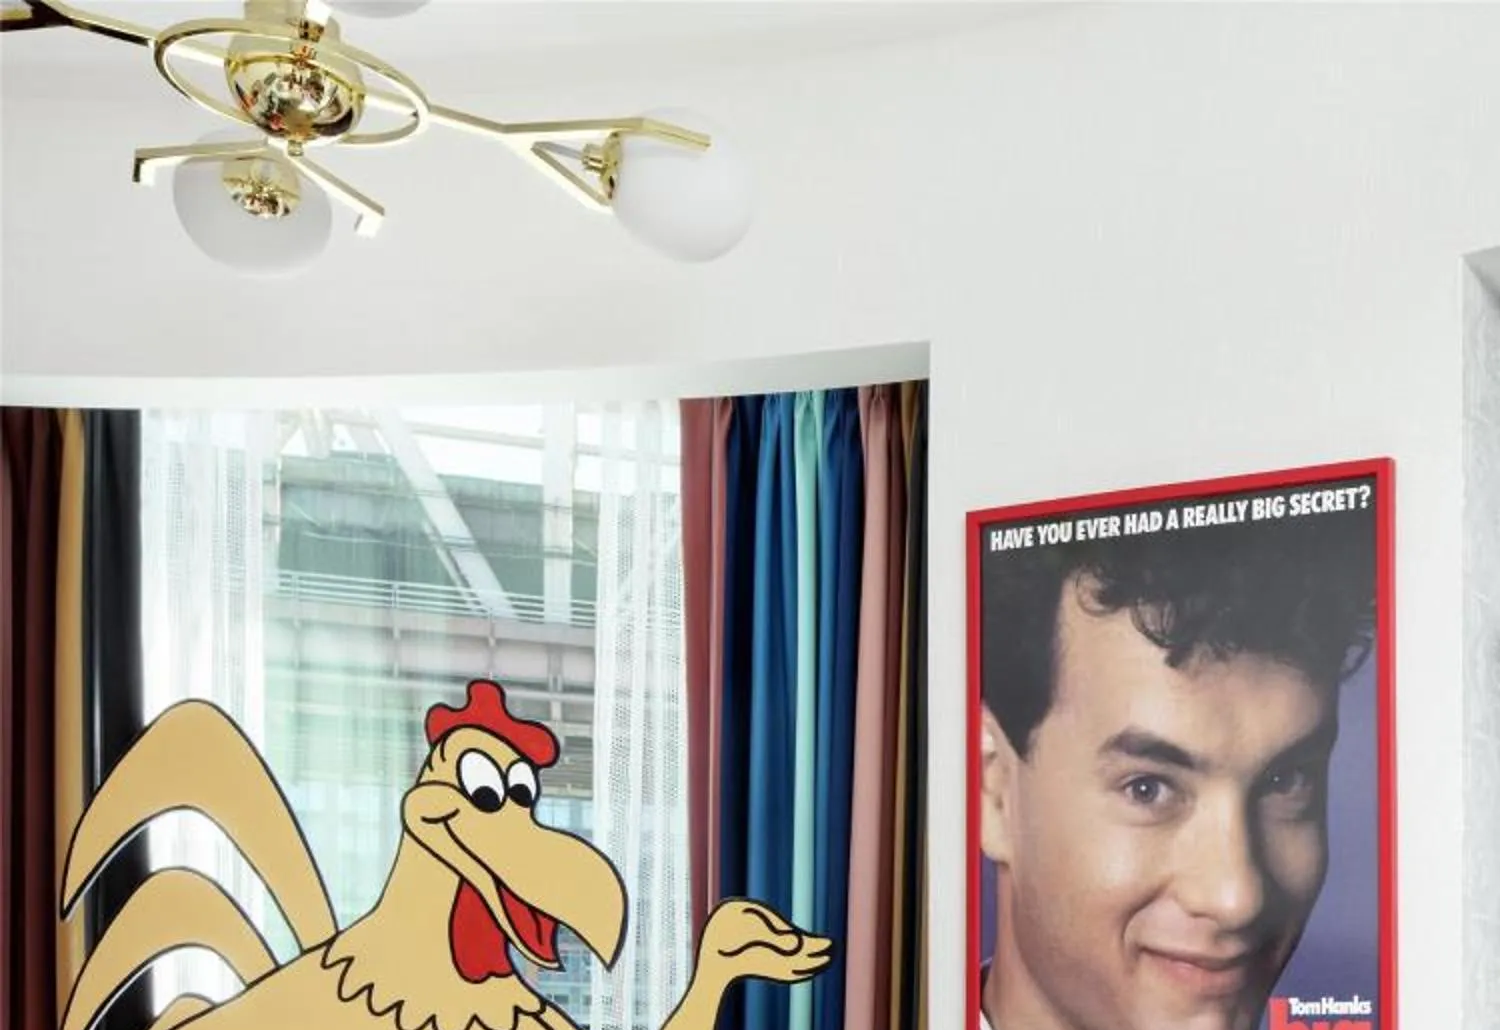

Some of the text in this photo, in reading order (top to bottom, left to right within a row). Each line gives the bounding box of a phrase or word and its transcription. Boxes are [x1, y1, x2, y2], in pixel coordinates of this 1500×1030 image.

[991, 485, 1371, 552] HAVE YOU EVER HAD A REALLY BIG SECRET?
[1288, 995, 1372, 1015] Tom Hanks
